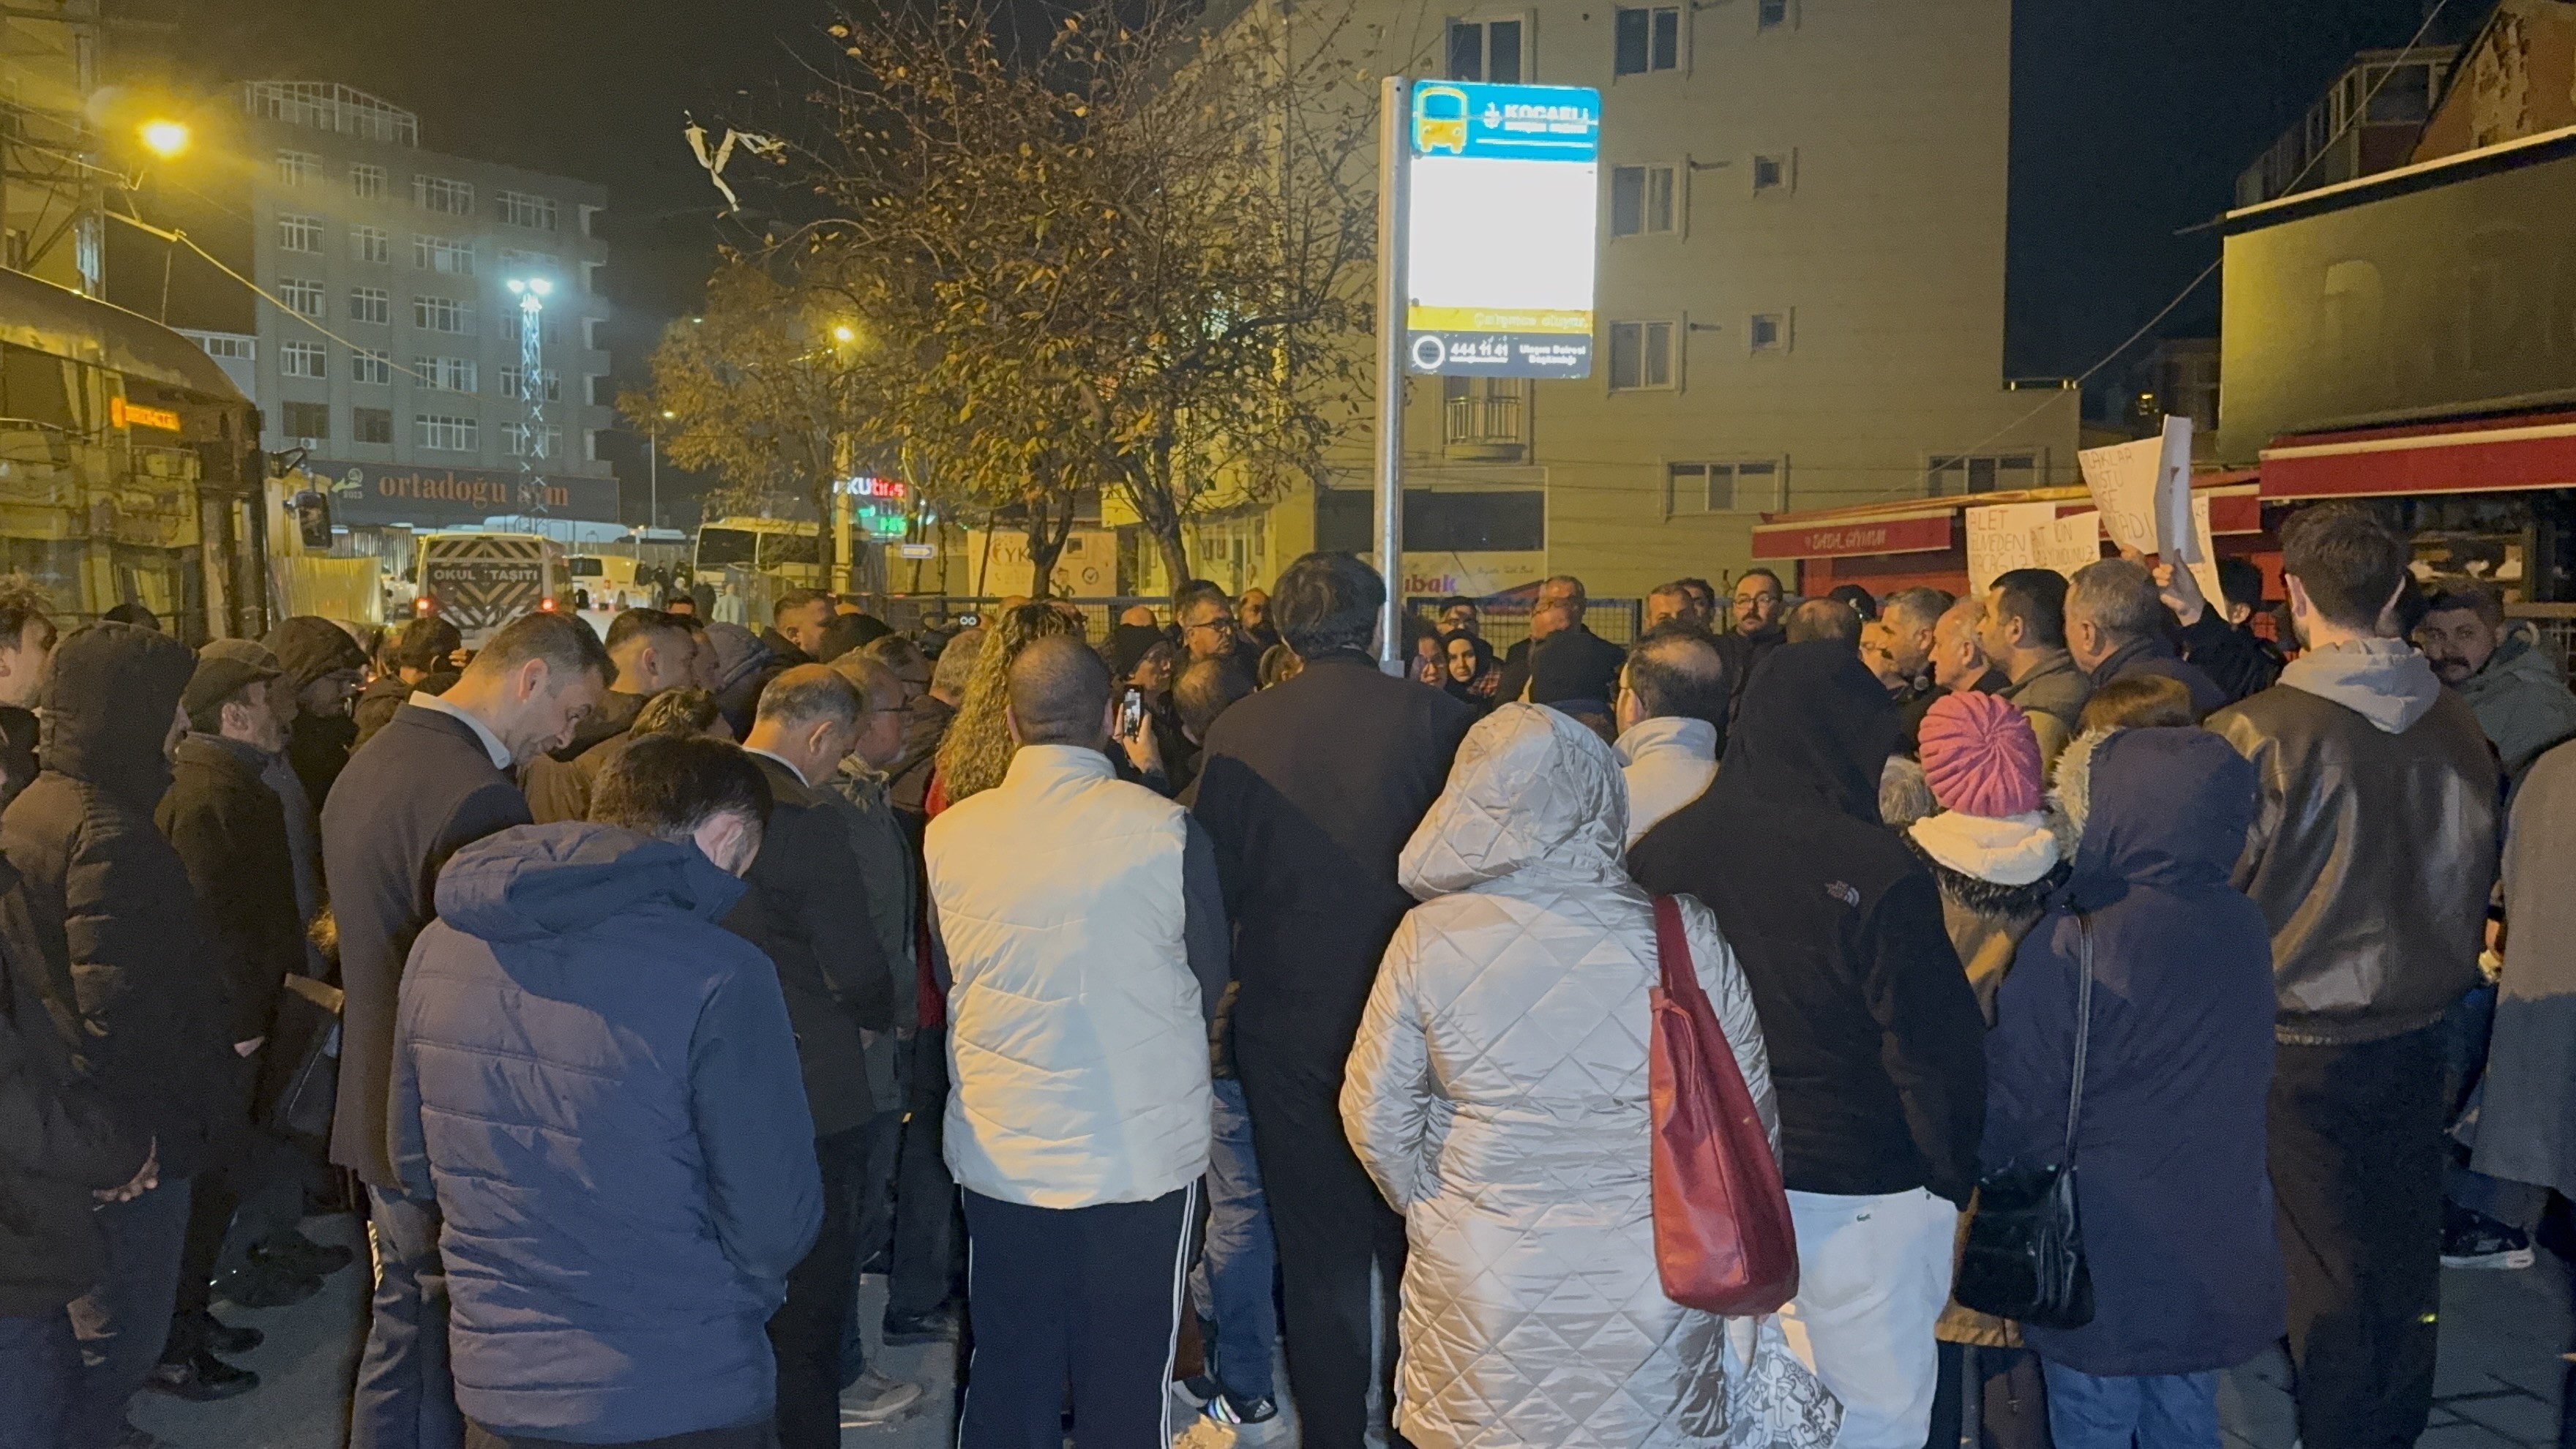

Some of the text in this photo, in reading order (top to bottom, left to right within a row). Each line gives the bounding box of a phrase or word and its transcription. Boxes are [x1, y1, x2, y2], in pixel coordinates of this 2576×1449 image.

[1450, 342, 1476, 356] 444
[1494, 344, 1508, 357] 41
[378, 471, 506, 510] ortadoğu
[433, 569, 538, 583] OKUL TAŞITI
